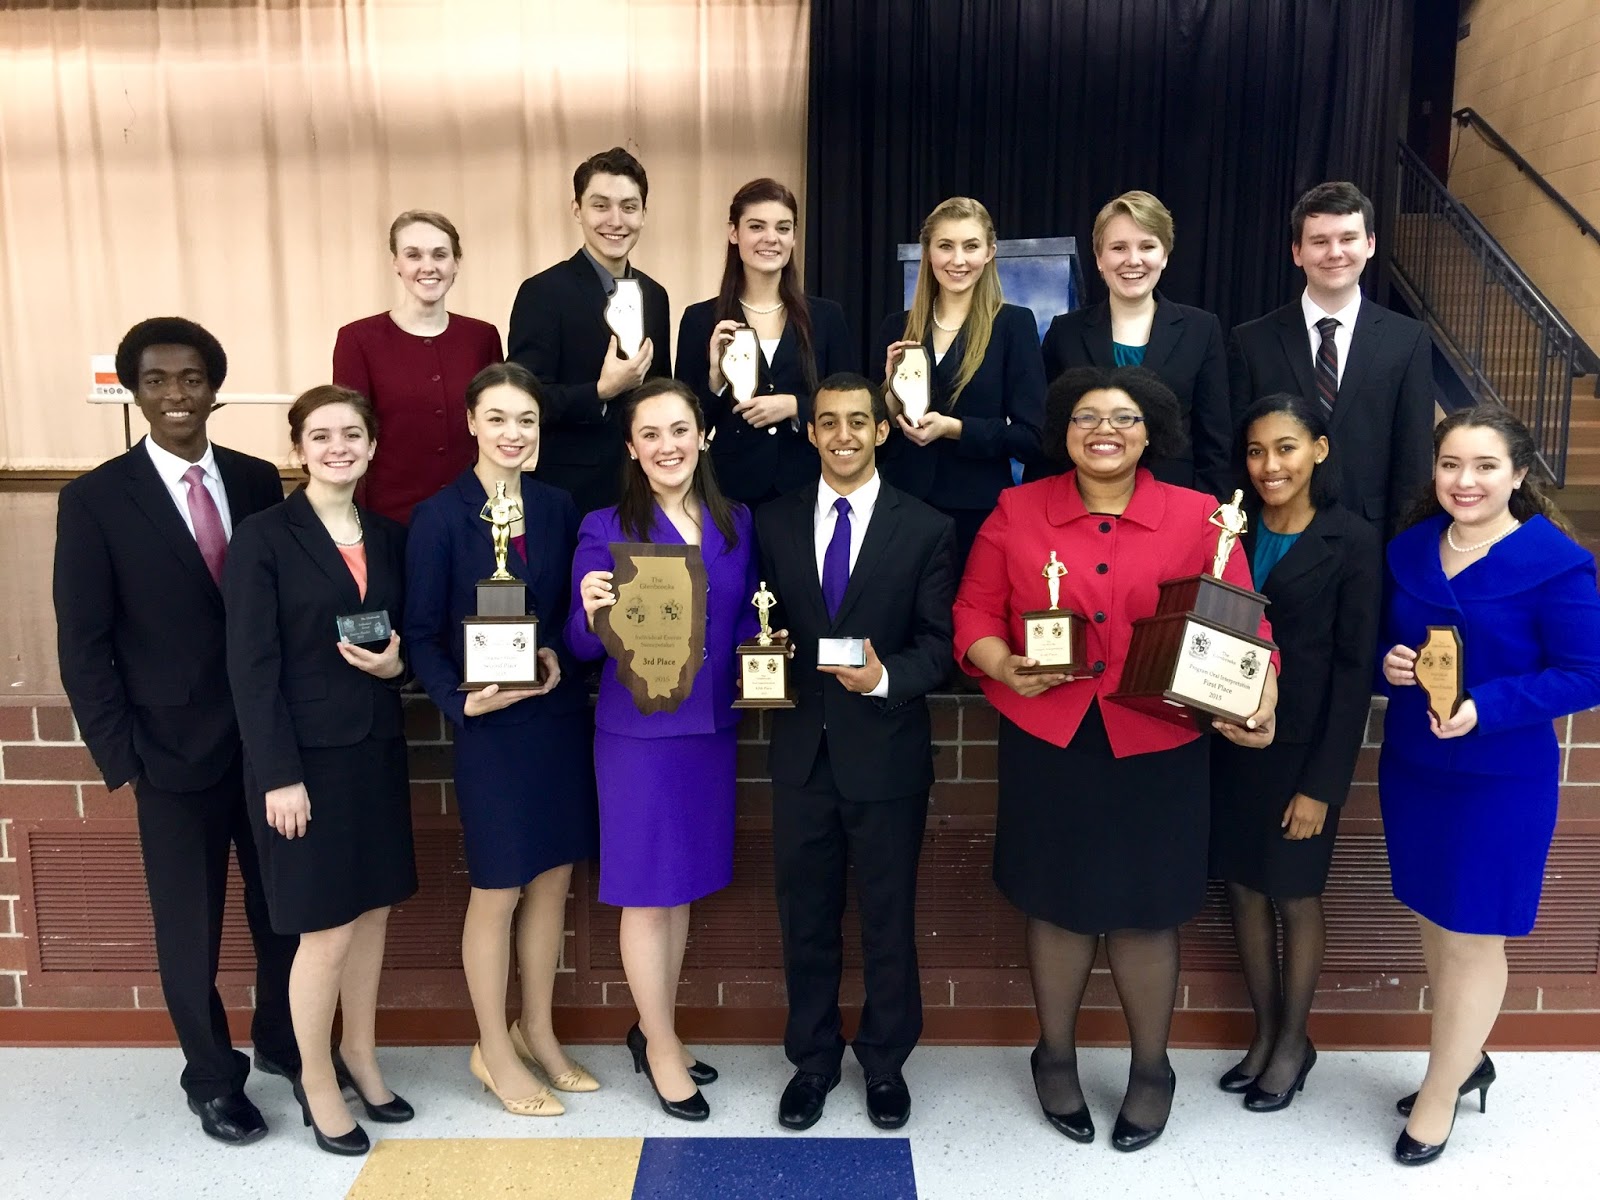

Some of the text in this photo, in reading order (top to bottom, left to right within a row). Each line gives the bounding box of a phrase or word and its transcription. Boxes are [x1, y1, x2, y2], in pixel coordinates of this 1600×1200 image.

[642, 657, 676, 666] 3rd Place
[1189, 663, 1250, 690] Program Oral Interpretation
[1203, 678, 1232, 694] First Place
[1209, 691, 1222, 701] 2015
